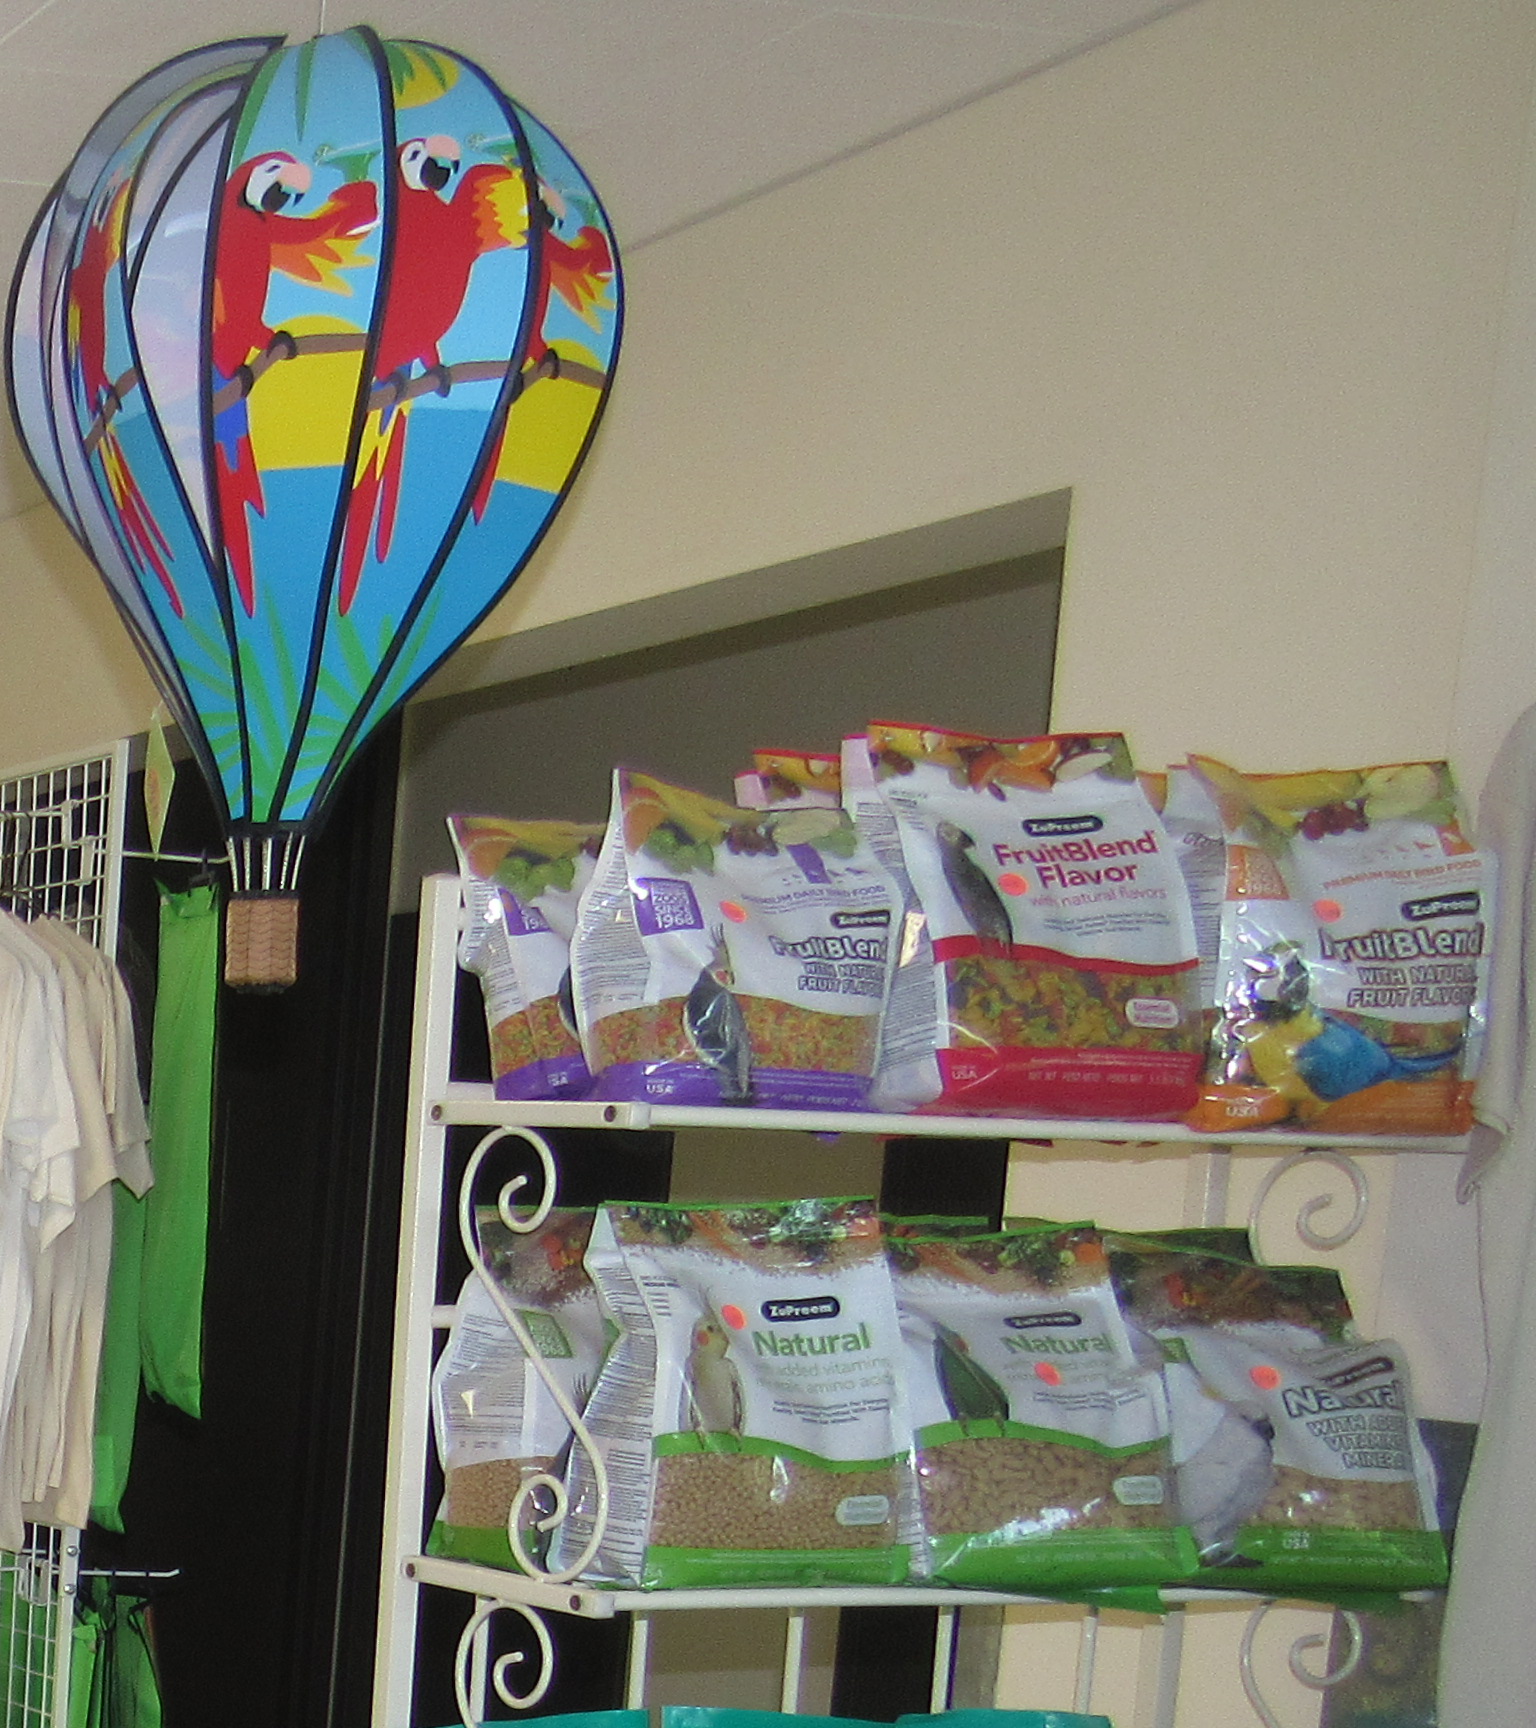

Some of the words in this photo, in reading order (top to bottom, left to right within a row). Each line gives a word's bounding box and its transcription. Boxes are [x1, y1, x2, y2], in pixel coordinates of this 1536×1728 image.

[993, 830, 1159, 866] FruitBlend
[1035, 863, 1138, 889] Flavor
[852, 884, 886, 896] FOOD
[1061, 889, 1120, 907] natural
[1120, 886, 1169, 901] flavors
[1357, 967, 1406, 985] WITH
[1347, 987, 1408, 1008] FRUIT
[647, 1083, 675, 1095] USA
[768, 1305, 833, 1317] ZuPreem
[751, 1322, 872, 1357] Natural
[1000, 1333, 1115, 1354] Natural
[1306, 1414, 1366, 1437] WITH
